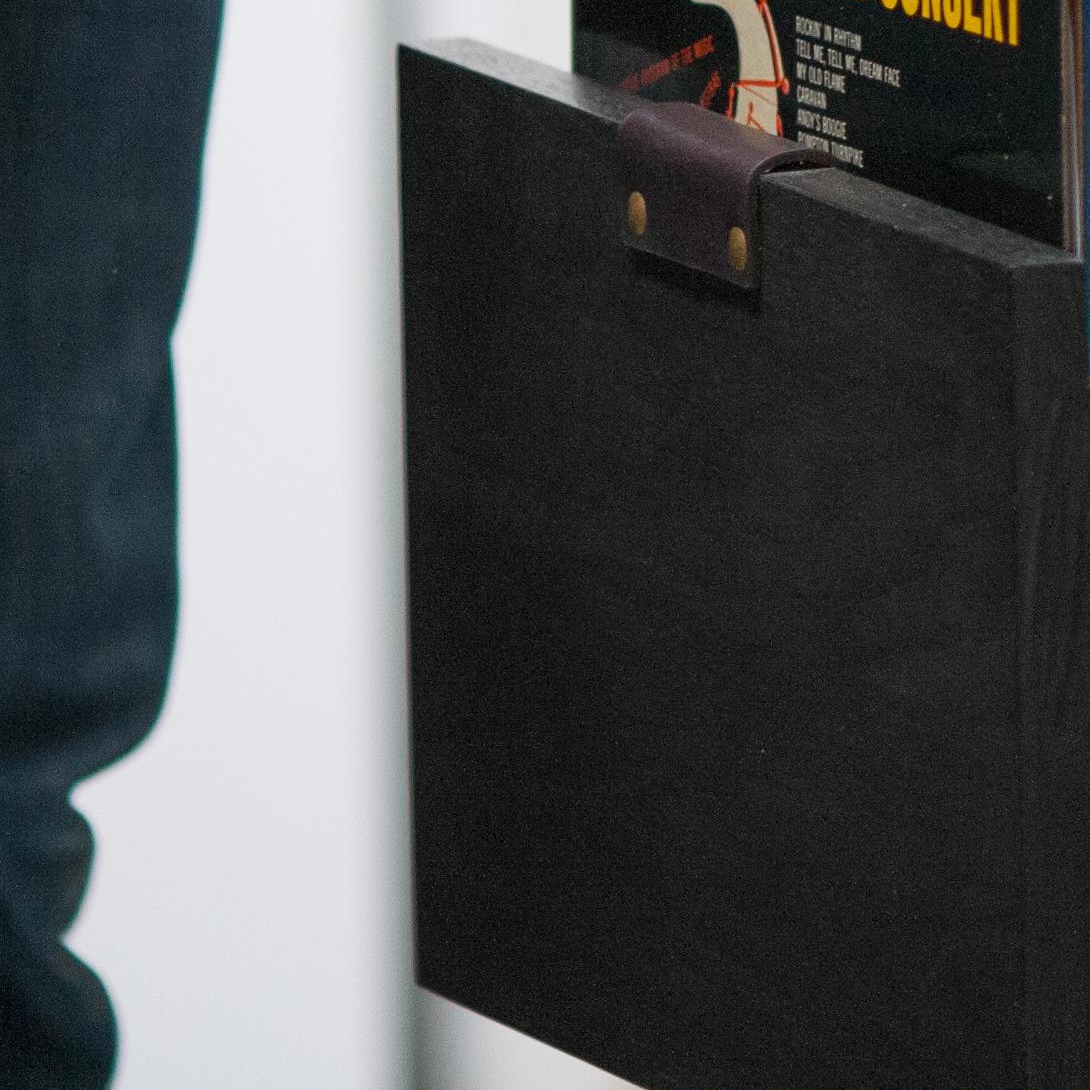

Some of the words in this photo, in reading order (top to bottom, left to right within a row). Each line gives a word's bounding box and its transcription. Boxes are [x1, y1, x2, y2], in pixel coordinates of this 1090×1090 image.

[833, 27, 862, 52] RHYTHM
[795, 38, 811, 59] TELL
[827, 48, 844, 69] TELL
[859, 58, 883, 81] DREAM
[883, 66, 901, 88] FACE
[796, 61, 807, 80] MY
[808, 66, 823, 86] OLD
[823, 70, 846, 94] FLAME
